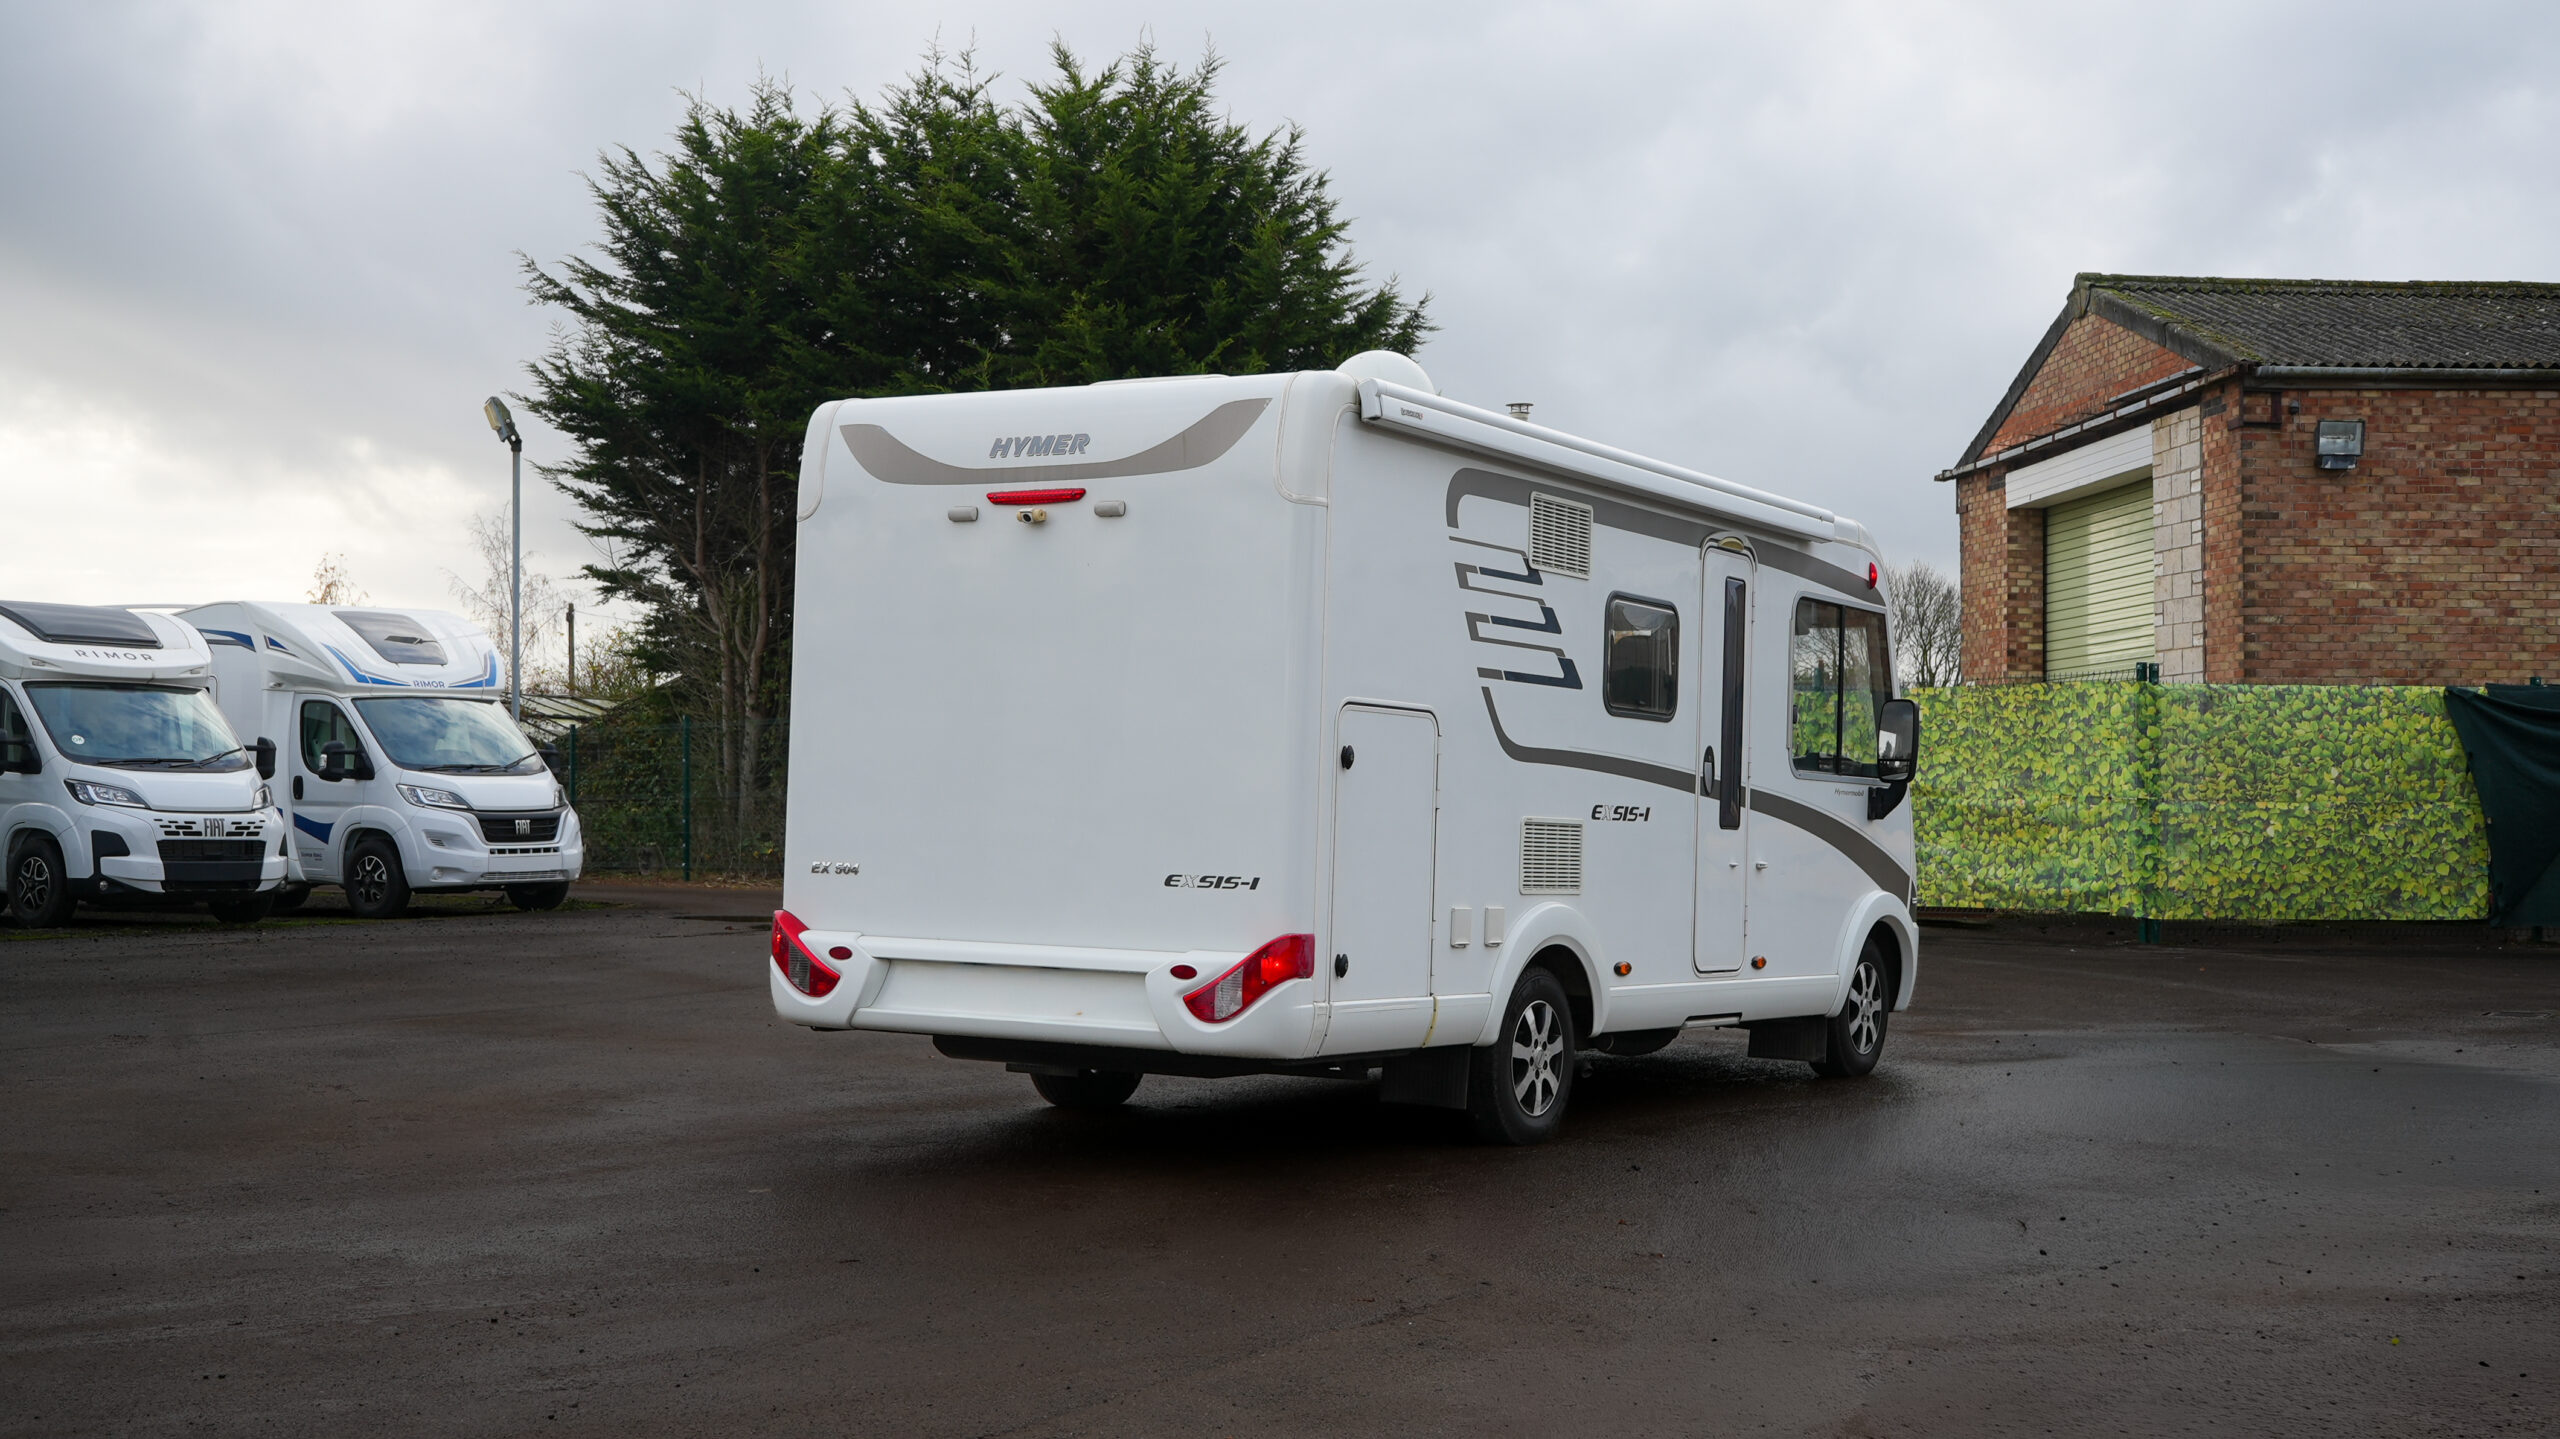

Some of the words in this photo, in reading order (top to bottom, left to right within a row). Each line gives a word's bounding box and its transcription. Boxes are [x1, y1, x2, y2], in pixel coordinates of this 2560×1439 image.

[989, 433, 1091, 458] HYMER
[74, 648, 155, 661] RIMOR
[413, 679, 446, 688] RIMOR
[1591, 804, 1651, 822] EXSIS-I
[203, 818, 225, 837] FIAT
[515, 819, 531, 835] FIAT
[811, 861, 832, 874] EX
[834, 862, 860, 875] 504
[1164, 874, 1261, 890] EXSIS-I
